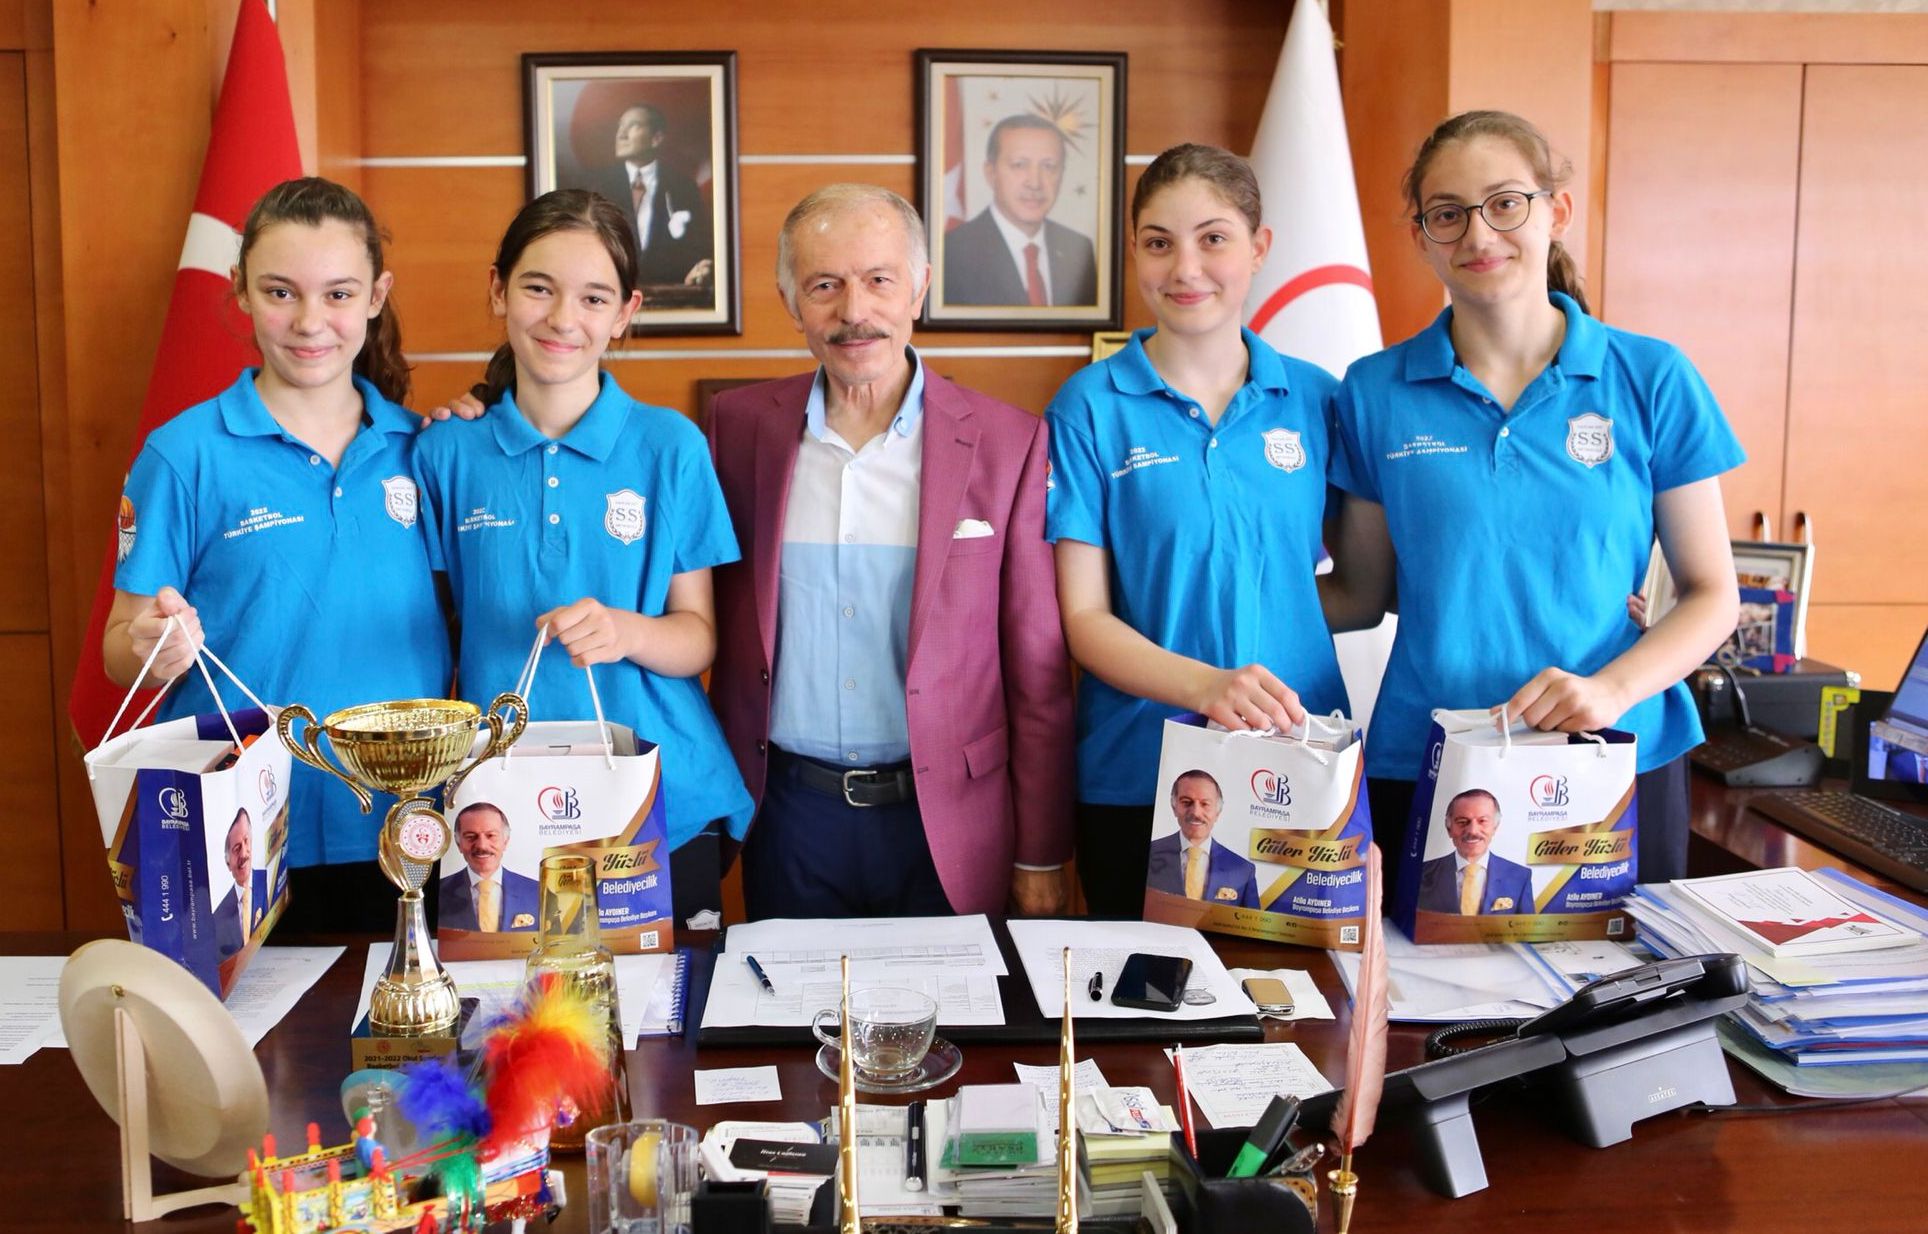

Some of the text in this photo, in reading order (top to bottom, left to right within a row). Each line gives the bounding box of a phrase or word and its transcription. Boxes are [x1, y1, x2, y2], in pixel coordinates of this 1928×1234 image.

[615, 507, 638, 521] SS
[1256, 837, 1353, 863] Güler Yüzlü
[1534, 838, 1626, 857] Güler Yüzlü
[602, 849, 650, 871] Yüzlü
[1306, 870, 1363, 888] Belediyecilik
[1580, 861, 1630, 880] Belediyecilik
[161, 874, 170, 890] 990
[602, 874, 658, 895] Belediyecilik
[162, 898, 170, 913] 444
